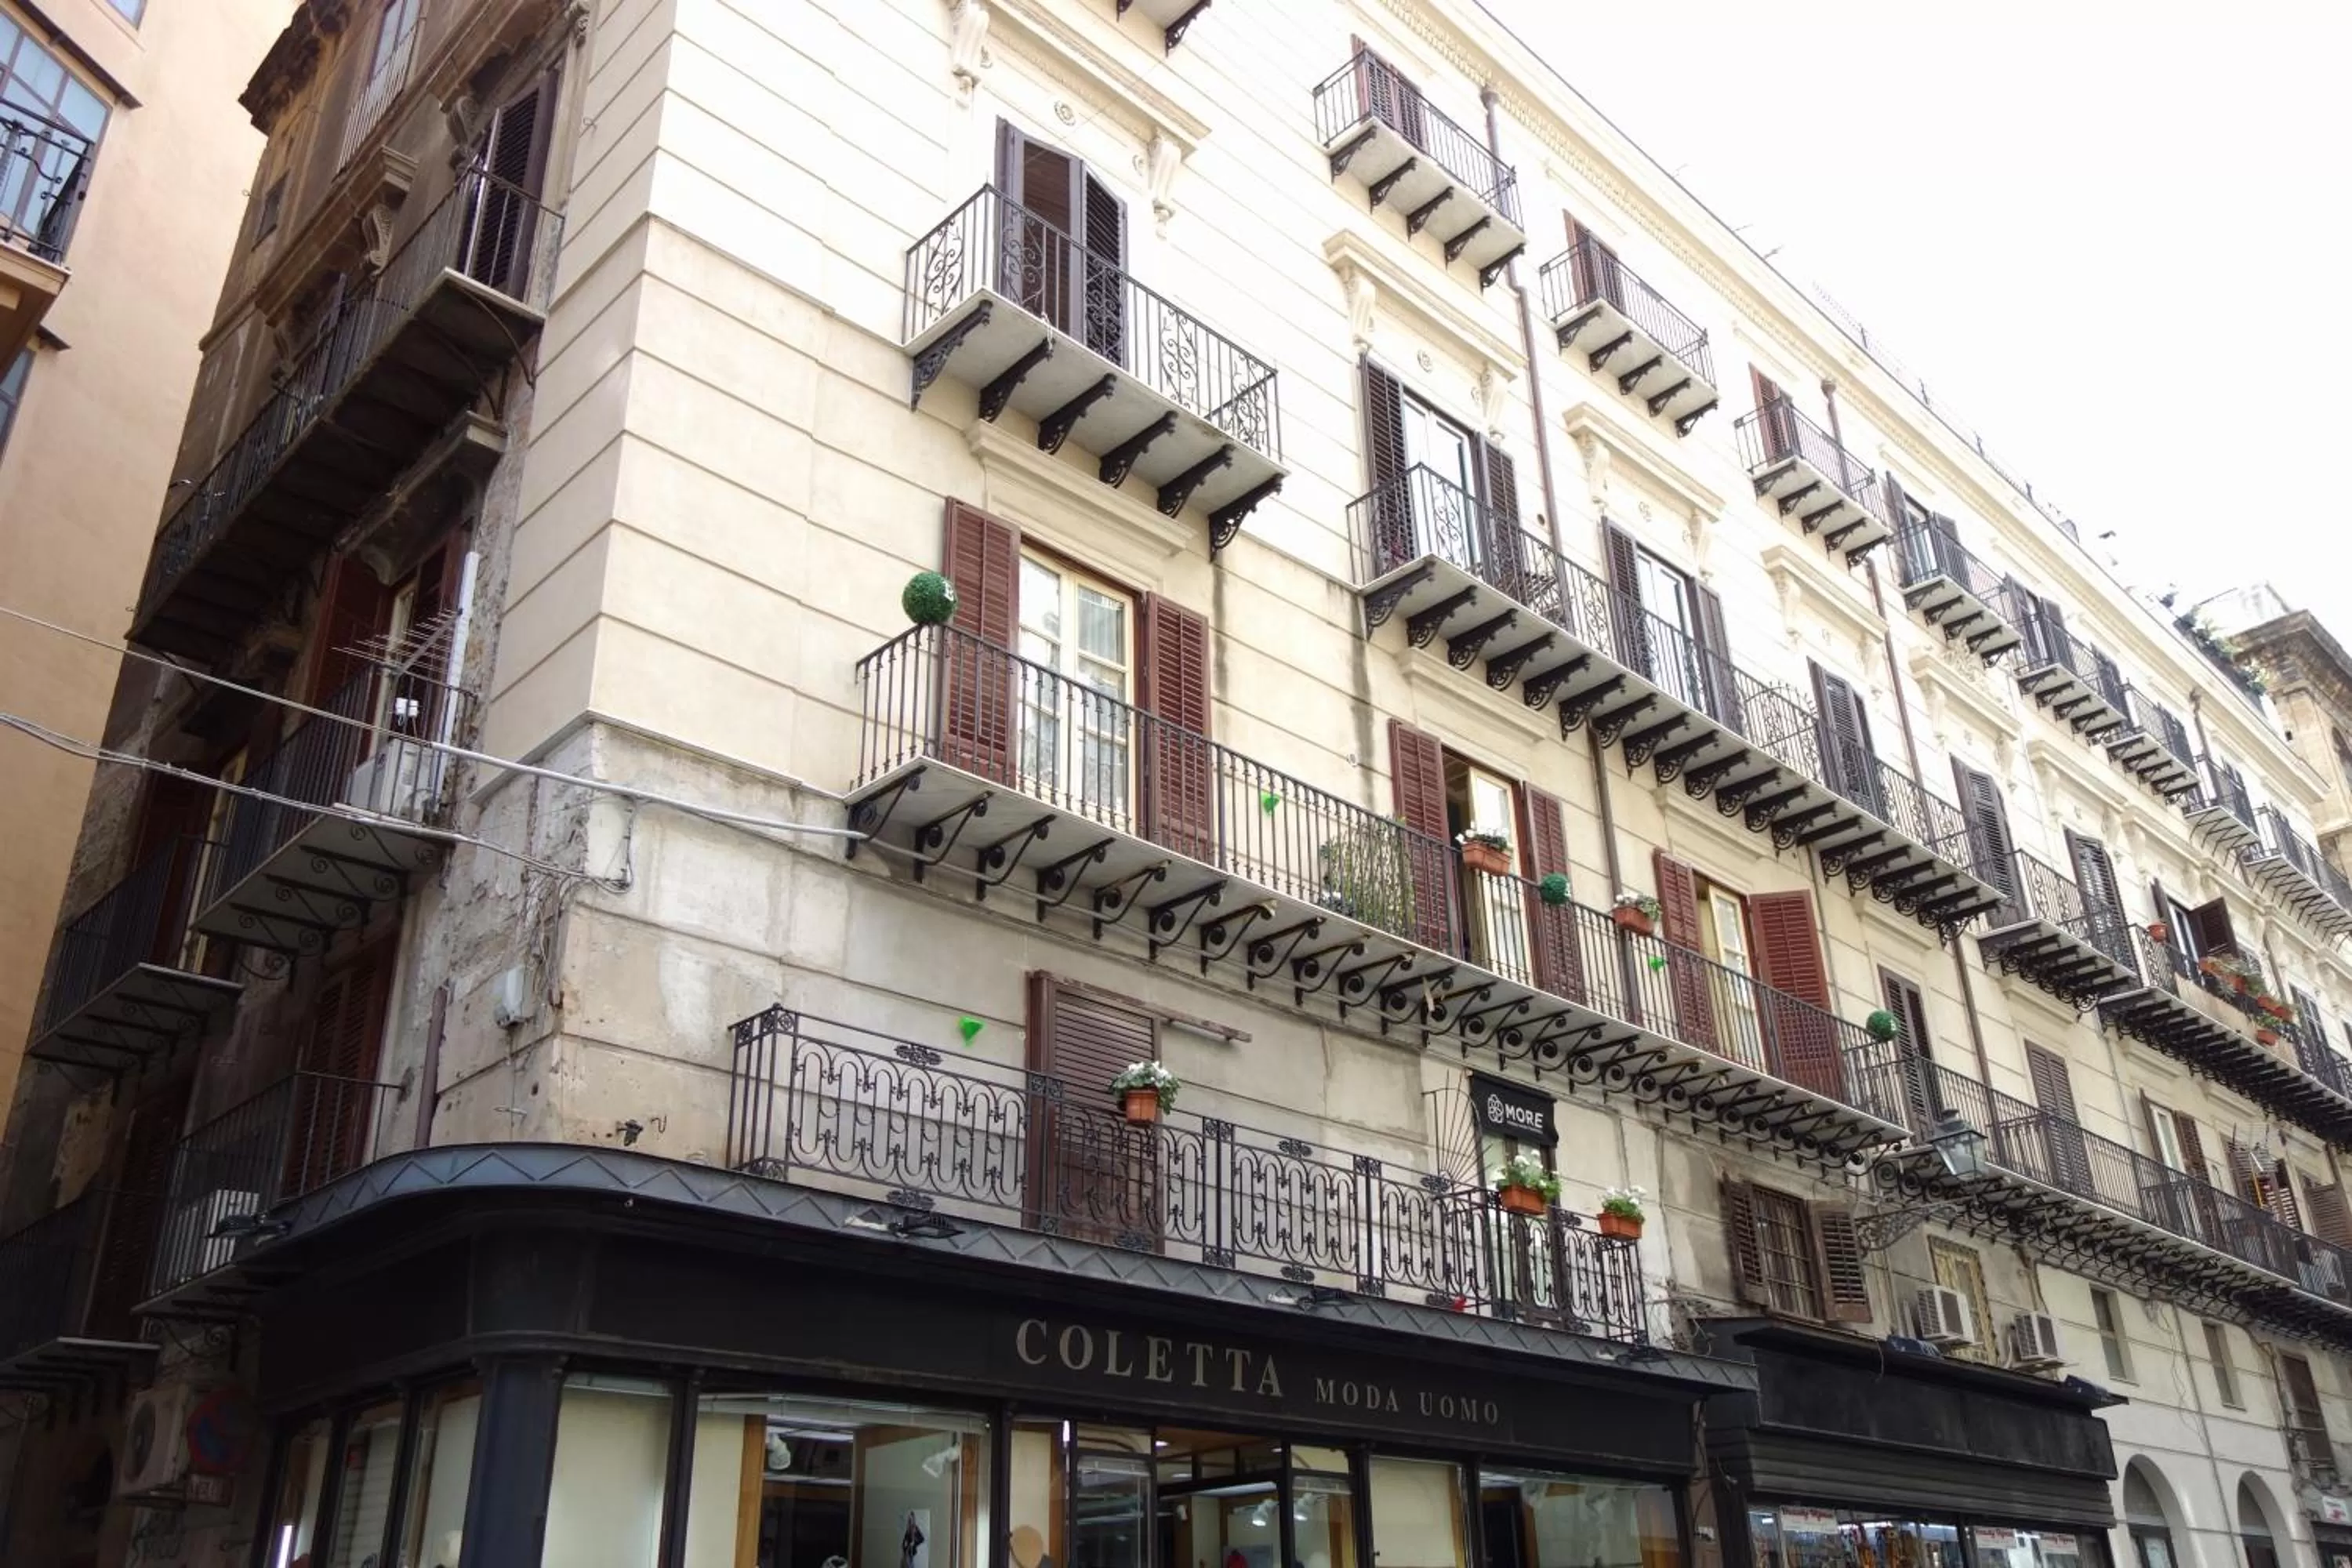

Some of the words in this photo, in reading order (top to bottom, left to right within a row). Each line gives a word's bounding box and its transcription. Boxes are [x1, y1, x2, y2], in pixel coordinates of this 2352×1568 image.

[1504, 1103, 1544, 1128] MORE
[1016, 1319, 1283, 1398] COLETTA
[1316, 1377, 1399, 1412] MODA
[1419, 1392, 1497, 1425] UOMO
